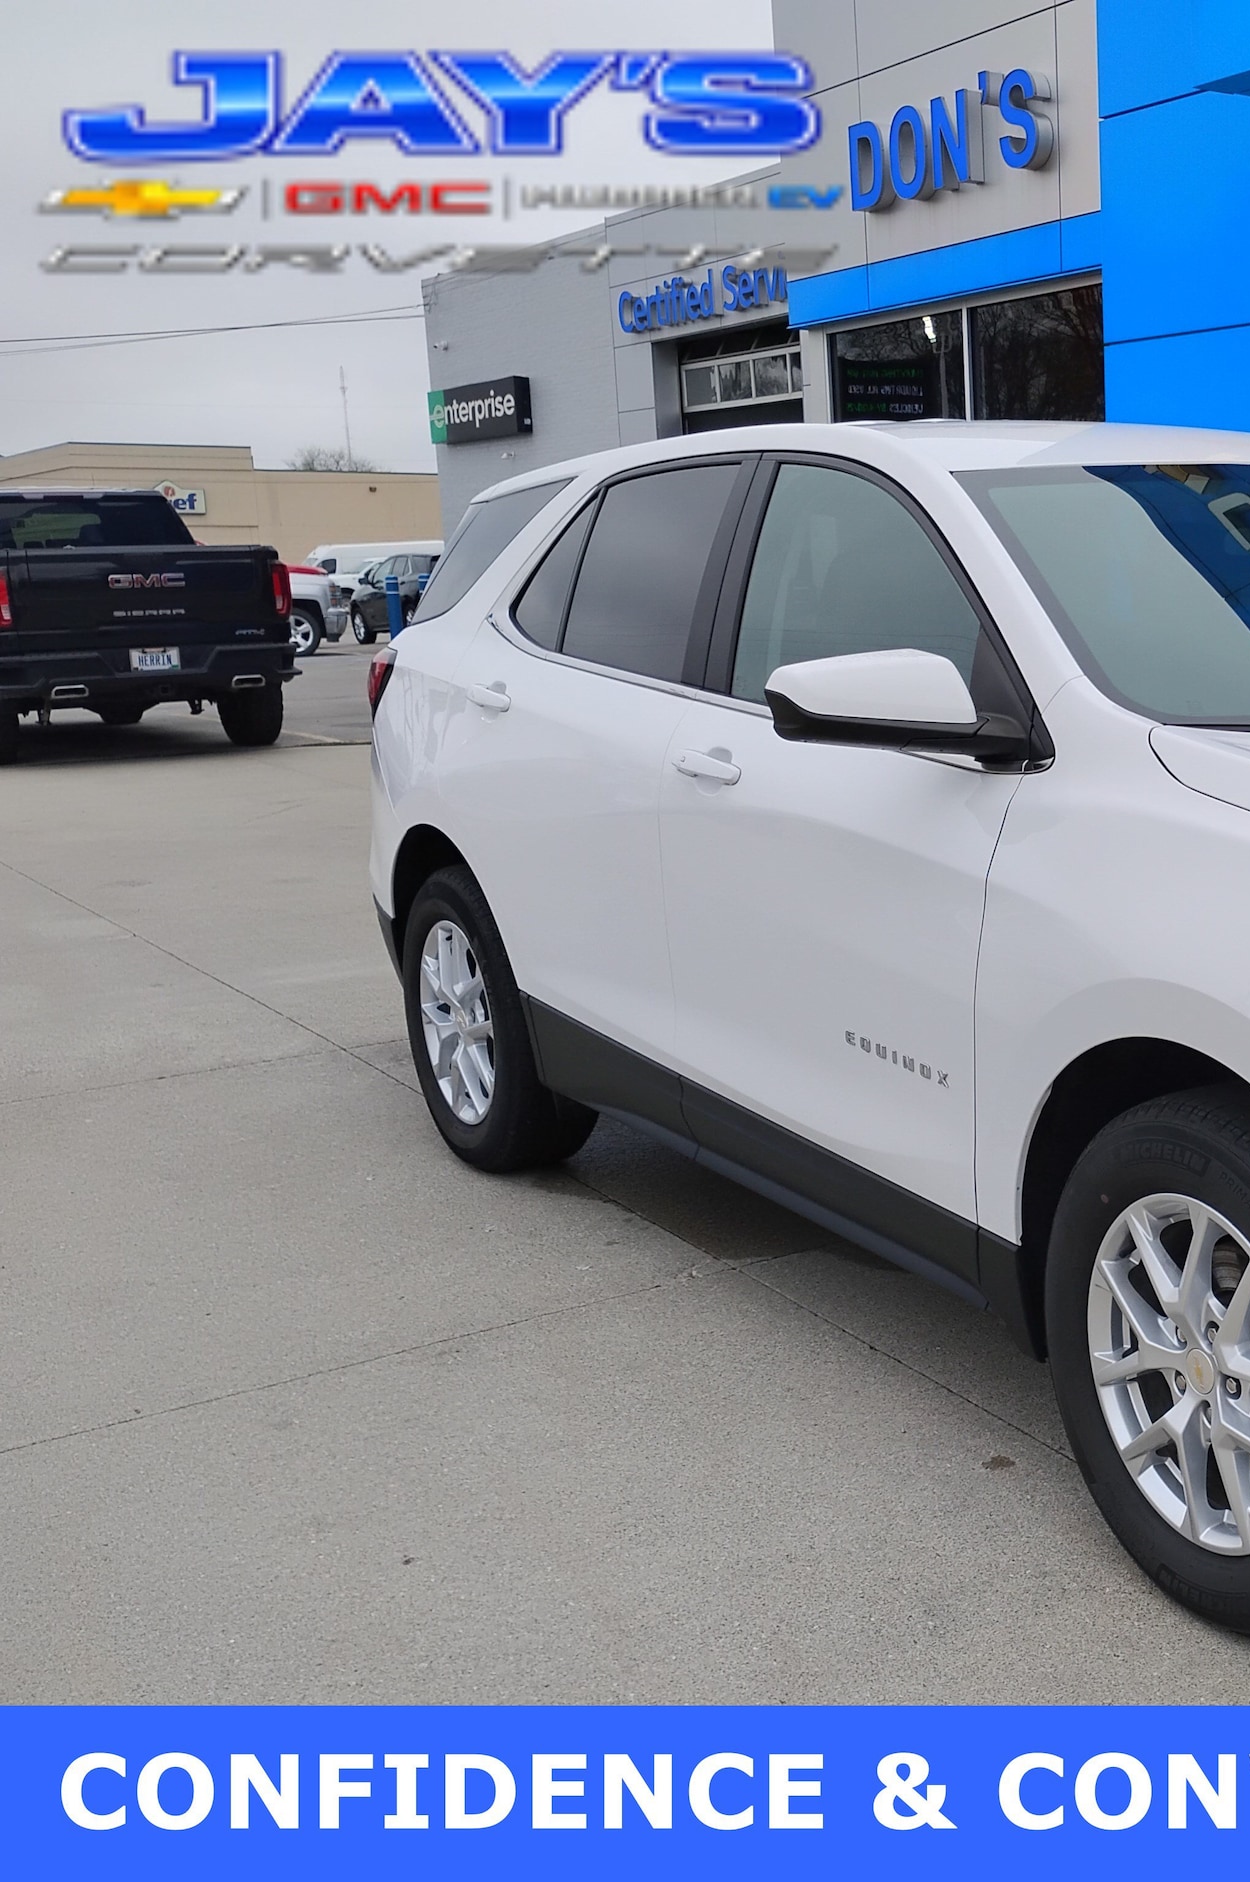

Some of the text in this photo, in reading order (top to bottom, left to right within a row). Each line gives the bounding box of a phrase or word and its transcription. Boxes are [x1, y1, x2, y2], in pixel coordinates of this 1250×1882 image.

[848, 68, 1054, 213] DON'S
[618, 265, 788, 333] Certified Servi
[430, 389, 515, 428] enterprise
[108, 573, 186, 589] GMC
[138, 654, 172, 667] HERRIN
[845, 1030, 950, 1088] EQUINOX
[1120, 1142, 1205, 1173] MICHELIN
